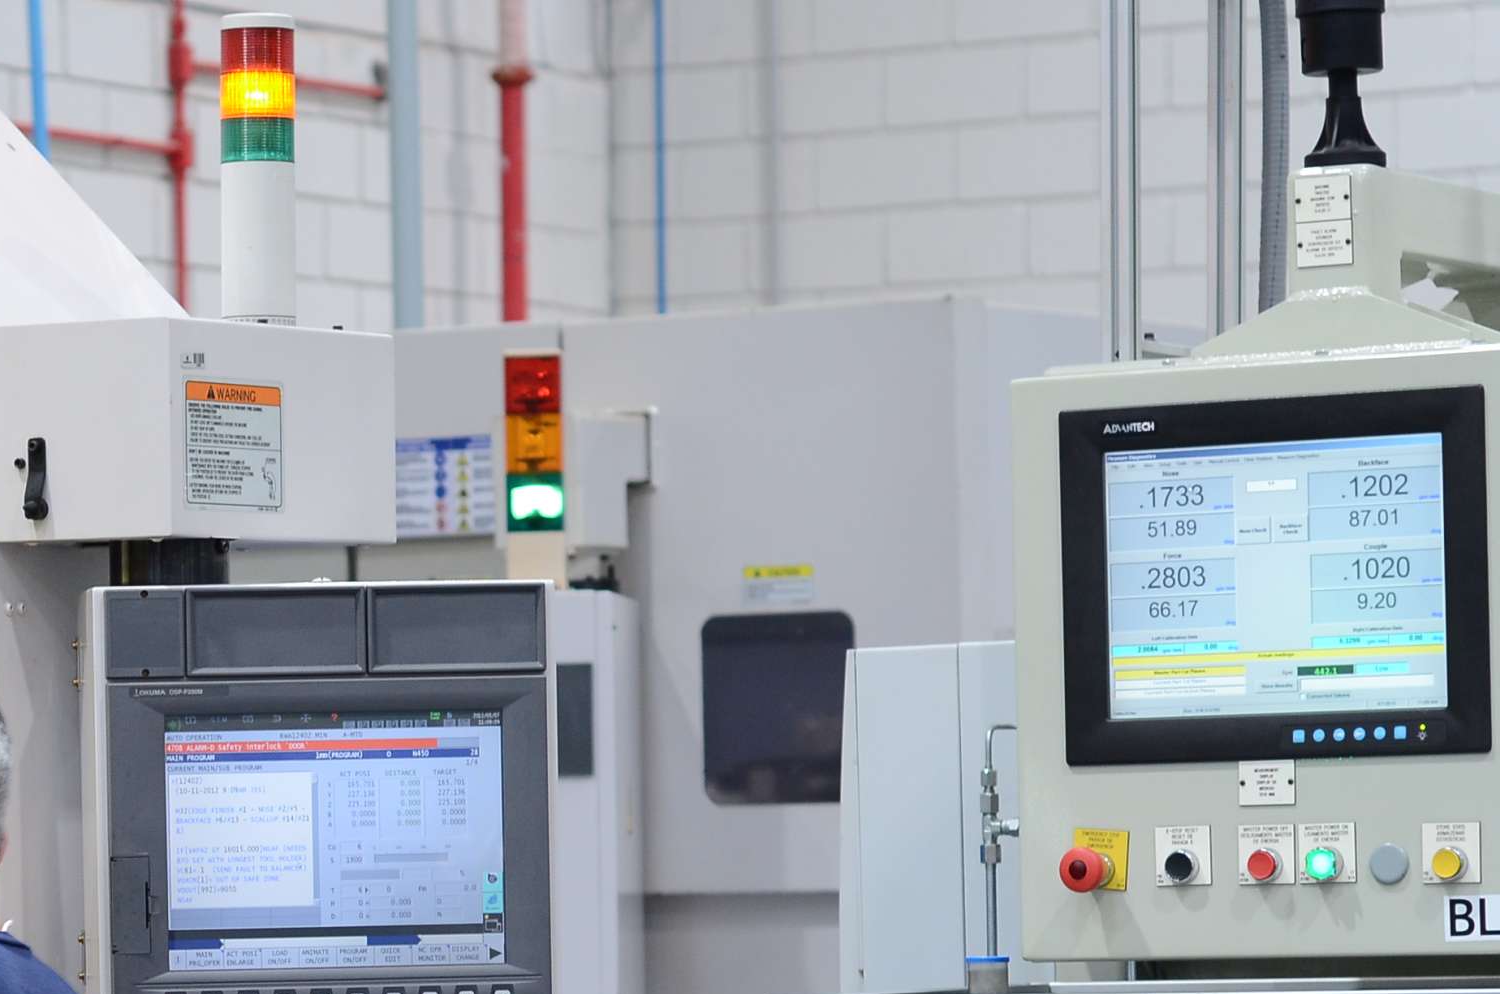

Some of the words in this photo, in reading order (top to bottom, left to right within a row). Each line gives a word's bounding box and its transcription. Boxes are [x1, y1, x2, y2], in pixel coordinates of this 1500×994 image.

[217, 389, 256, 402] WARNING
[1103, 421, 1155, 435] ADVANTECH
[1342, 473, 1408, 499] .1202
[1140, 484, 1204, 509] .1733
[1348, 508, 1398, 528] 87.01
[1148, 518, 1197, 538] 51.89
[1141, 564, 1206, 590] .2803
[1343, 556, 1411, 581] .1020
[1148, 600, 1198, 618] 66.17
[1357, 591, 1398, 610] 9.20
[186, 744, 214, 752] ALARM-D
[218, 744, 243, 752] Safety
[246, 742, 282, 751] interlock
[166, 754, 184, 762] MAIN
[186, 754, 215, 762] PROGRAM
[198, 764, 230, 772] MAIN/SUB
[433, 768, 457, 776] TARGET
